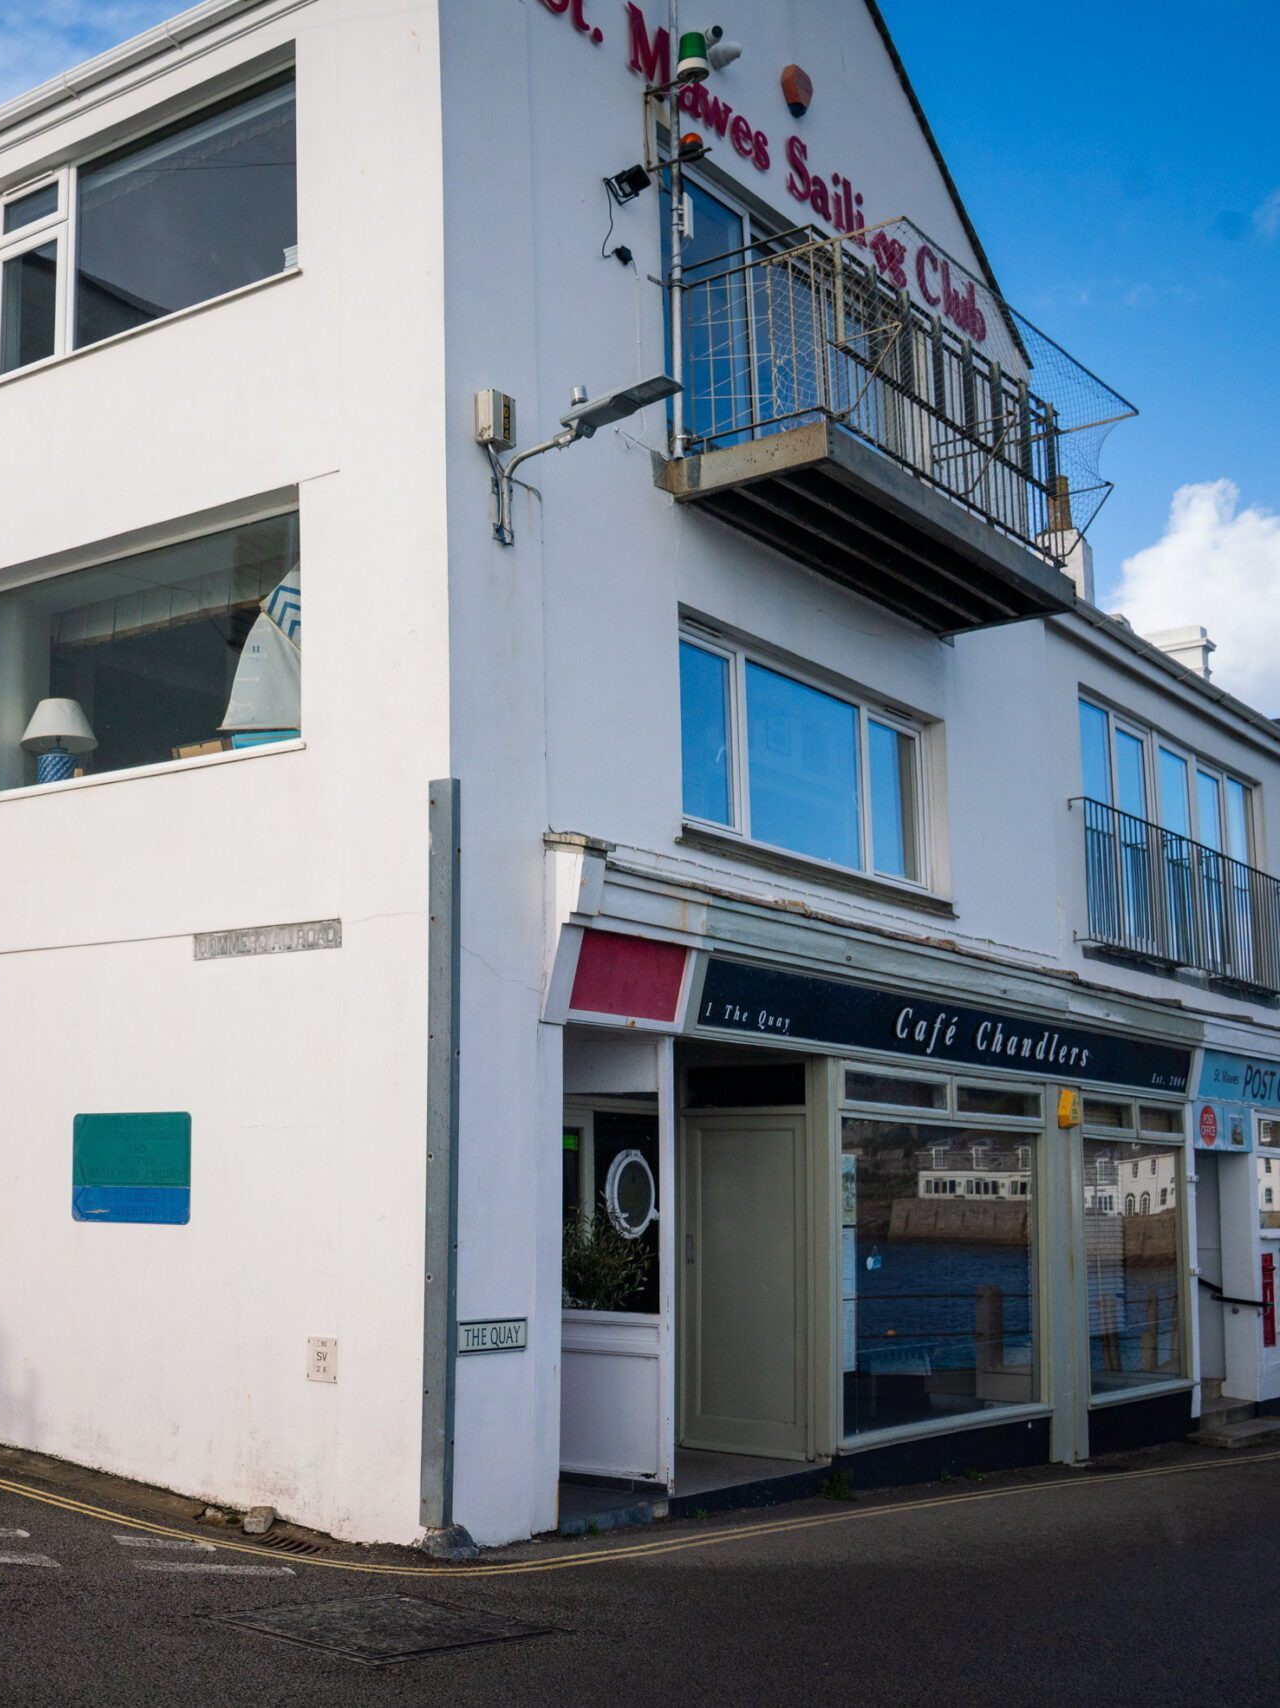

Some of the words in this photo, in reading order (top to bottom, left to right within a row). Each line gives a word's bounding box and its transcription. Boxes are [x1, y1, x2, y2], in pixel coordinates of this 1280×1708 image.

[540, 0, 604, 43] t.
[916, 246, 986, 342] Club
[296, 926, 337, 948] ROAD
[724, 1004, 748, 1022] The
[758, 1010, 790, 1033] Quay
[896, 1007, 959, 1055] Café
[976, 1021, 1090, 1068] Chandlers
[1243, 1064, 1276, 1100] POST
[464, 1327, 487, 1347] THE
[490, 1325, 521, 1348] QUAY
